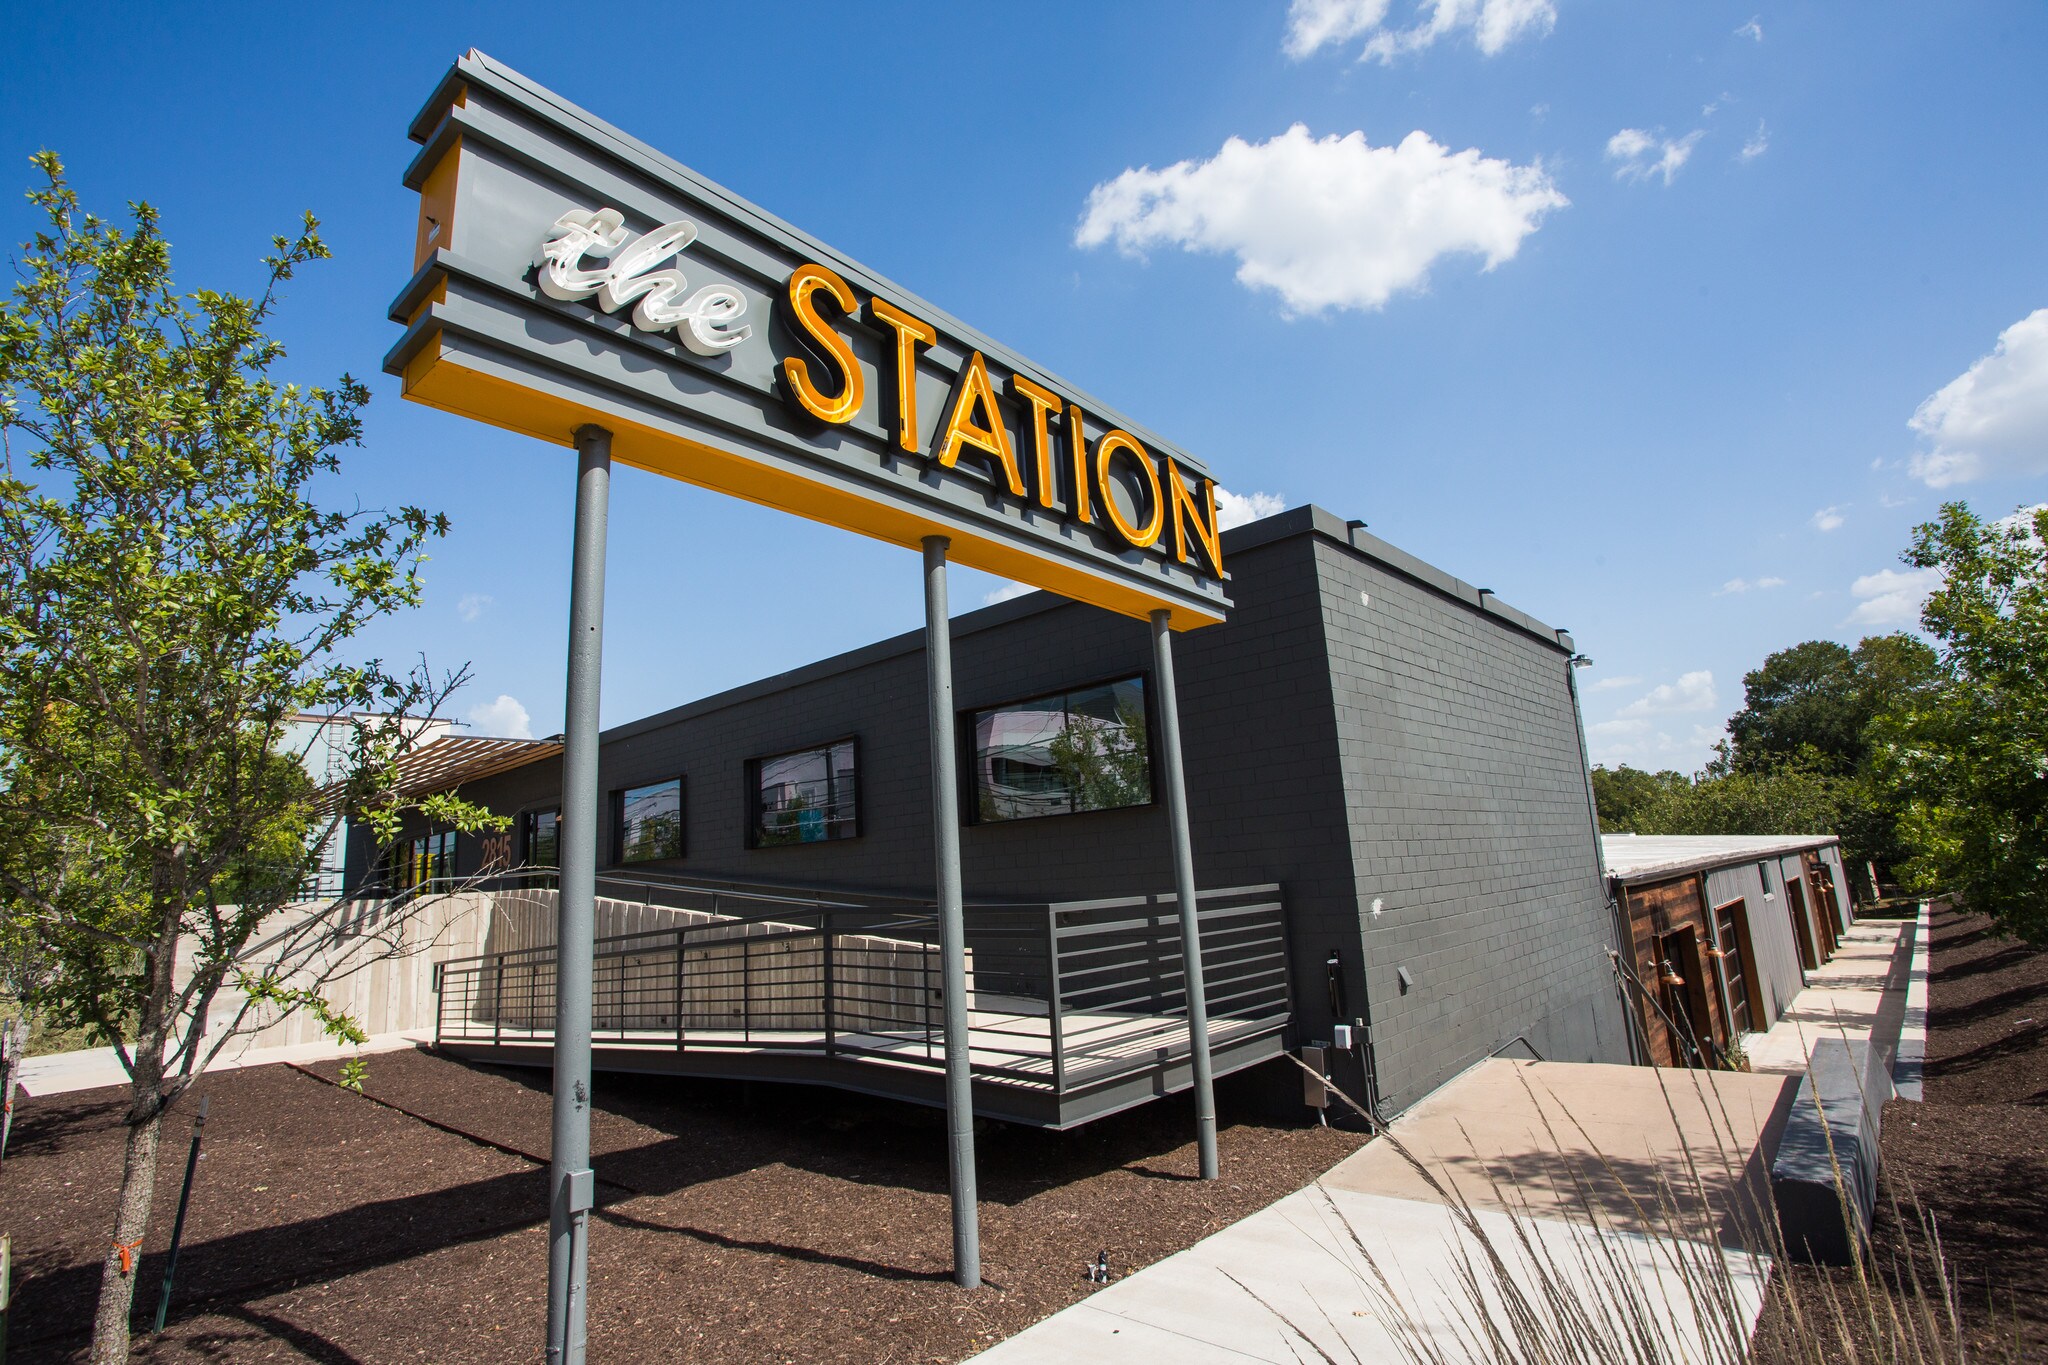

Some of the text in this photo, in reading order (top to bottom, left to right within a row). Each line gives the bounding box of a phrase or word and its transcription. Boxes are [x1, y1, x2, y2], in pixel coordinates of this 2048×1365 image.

[538, 207, 1224, 580] the STATION
[482, 834, 512, 868] 2815
